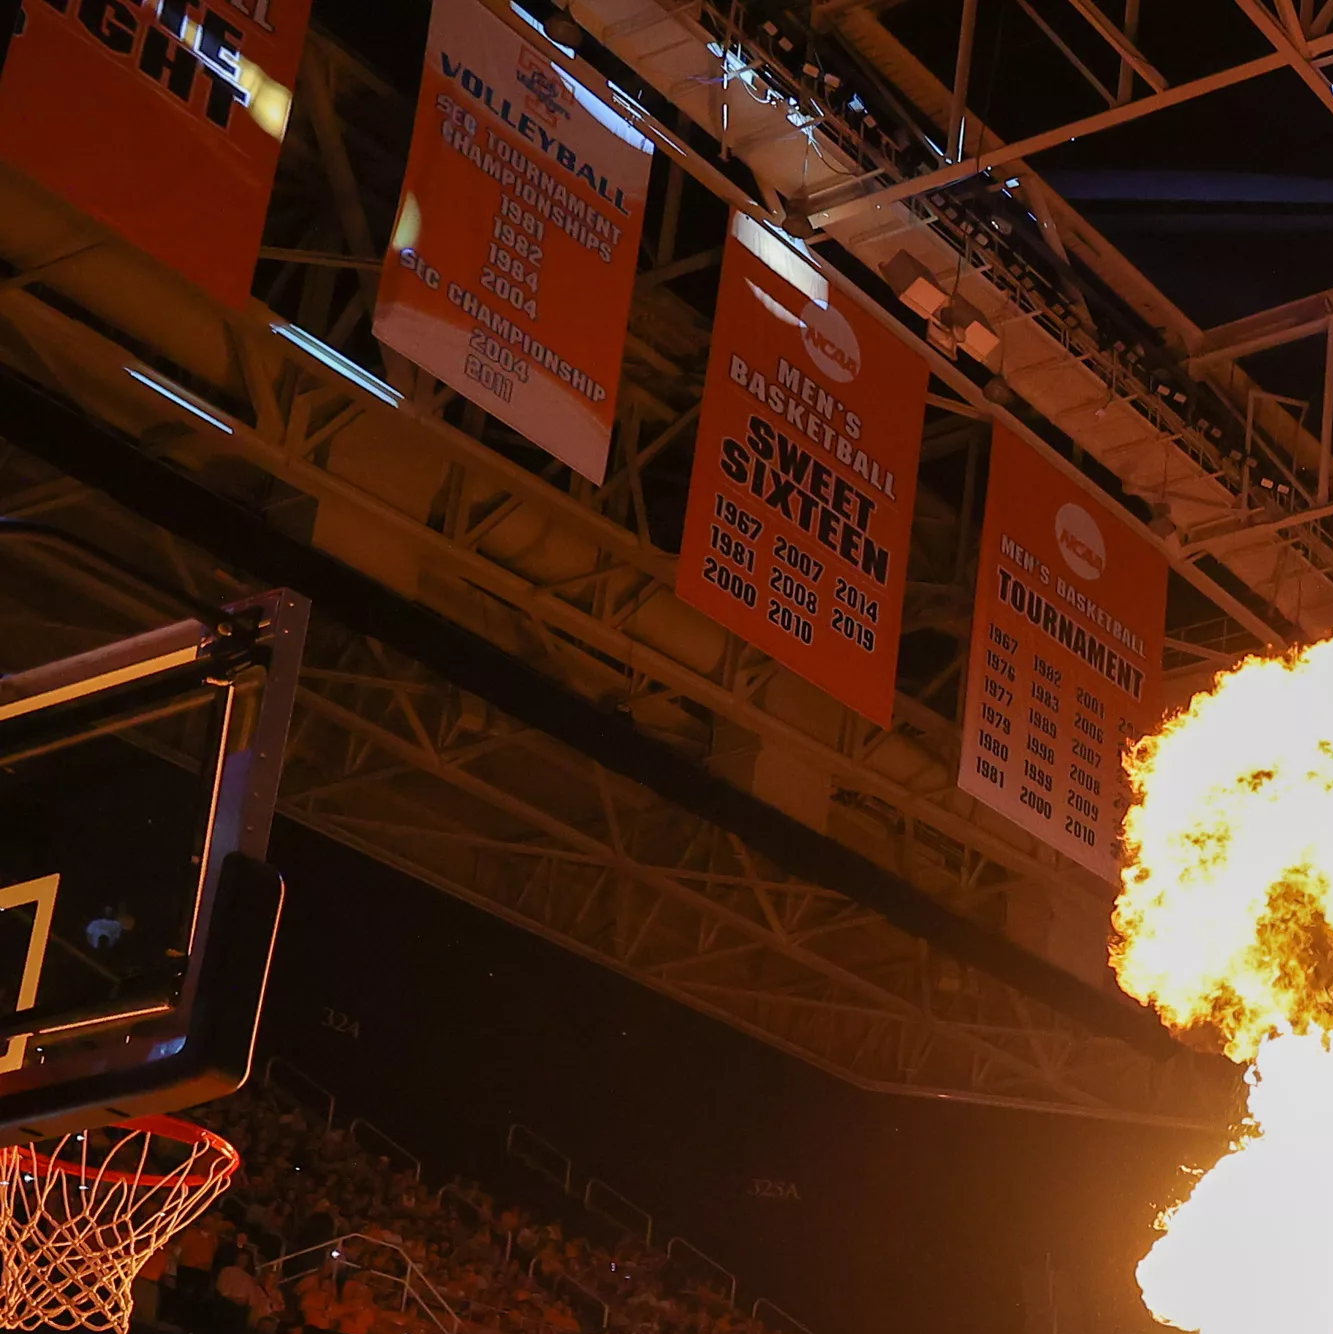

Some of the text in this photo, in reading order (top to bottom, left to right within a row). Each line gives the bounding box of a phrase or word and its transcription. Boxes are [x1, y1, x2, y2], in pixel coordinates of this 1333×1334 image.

[440, 51, 631, 216] VOLLEYBALL
[436, 94, 622, 246] SEC TOURNAMENT
[441, 116, 612, 264] CHAMPIONSHIPS
[493, 216, 544, 268] 1982
[501, 193, 545, 243] 1981
[480, 266, 538, 322] 2004
[488, 242, 540, 294] 1984
[401, 248, 607, 403] SEC CHAMPIONSHIP
[469, 328, 530, 383] 2004
[464, 353, 513, 403] 2011
[778, 357, 863, 440] MEN'S
[729, 354, 897, 501] BASKETBALL
[746, 414, 878, 534] SWEET
[720, 437, 890, 587] SIXTEEN
[710, 524, 877, 654] 1981 2008 2019
[715, 492, 880, 625] 1967 2007 2014
[703, 556, 814, 646] 2000 2010
[1001, 534, 1148, 661] MEN'S BASKETBALL
[989, 622, 1019, 656] 1967
[997, 564, 1147, 703] TOURNAMENT
[981, 702, 1011, 736] 1979
[984, 676, 1014, 708] 1977
[976, 756, 1005, 789] 1981
[978, 729, 1009, 763] 1980
[1019, 787, 1053, 820] 2000
[1065, 816, 1096, 848] 2010
